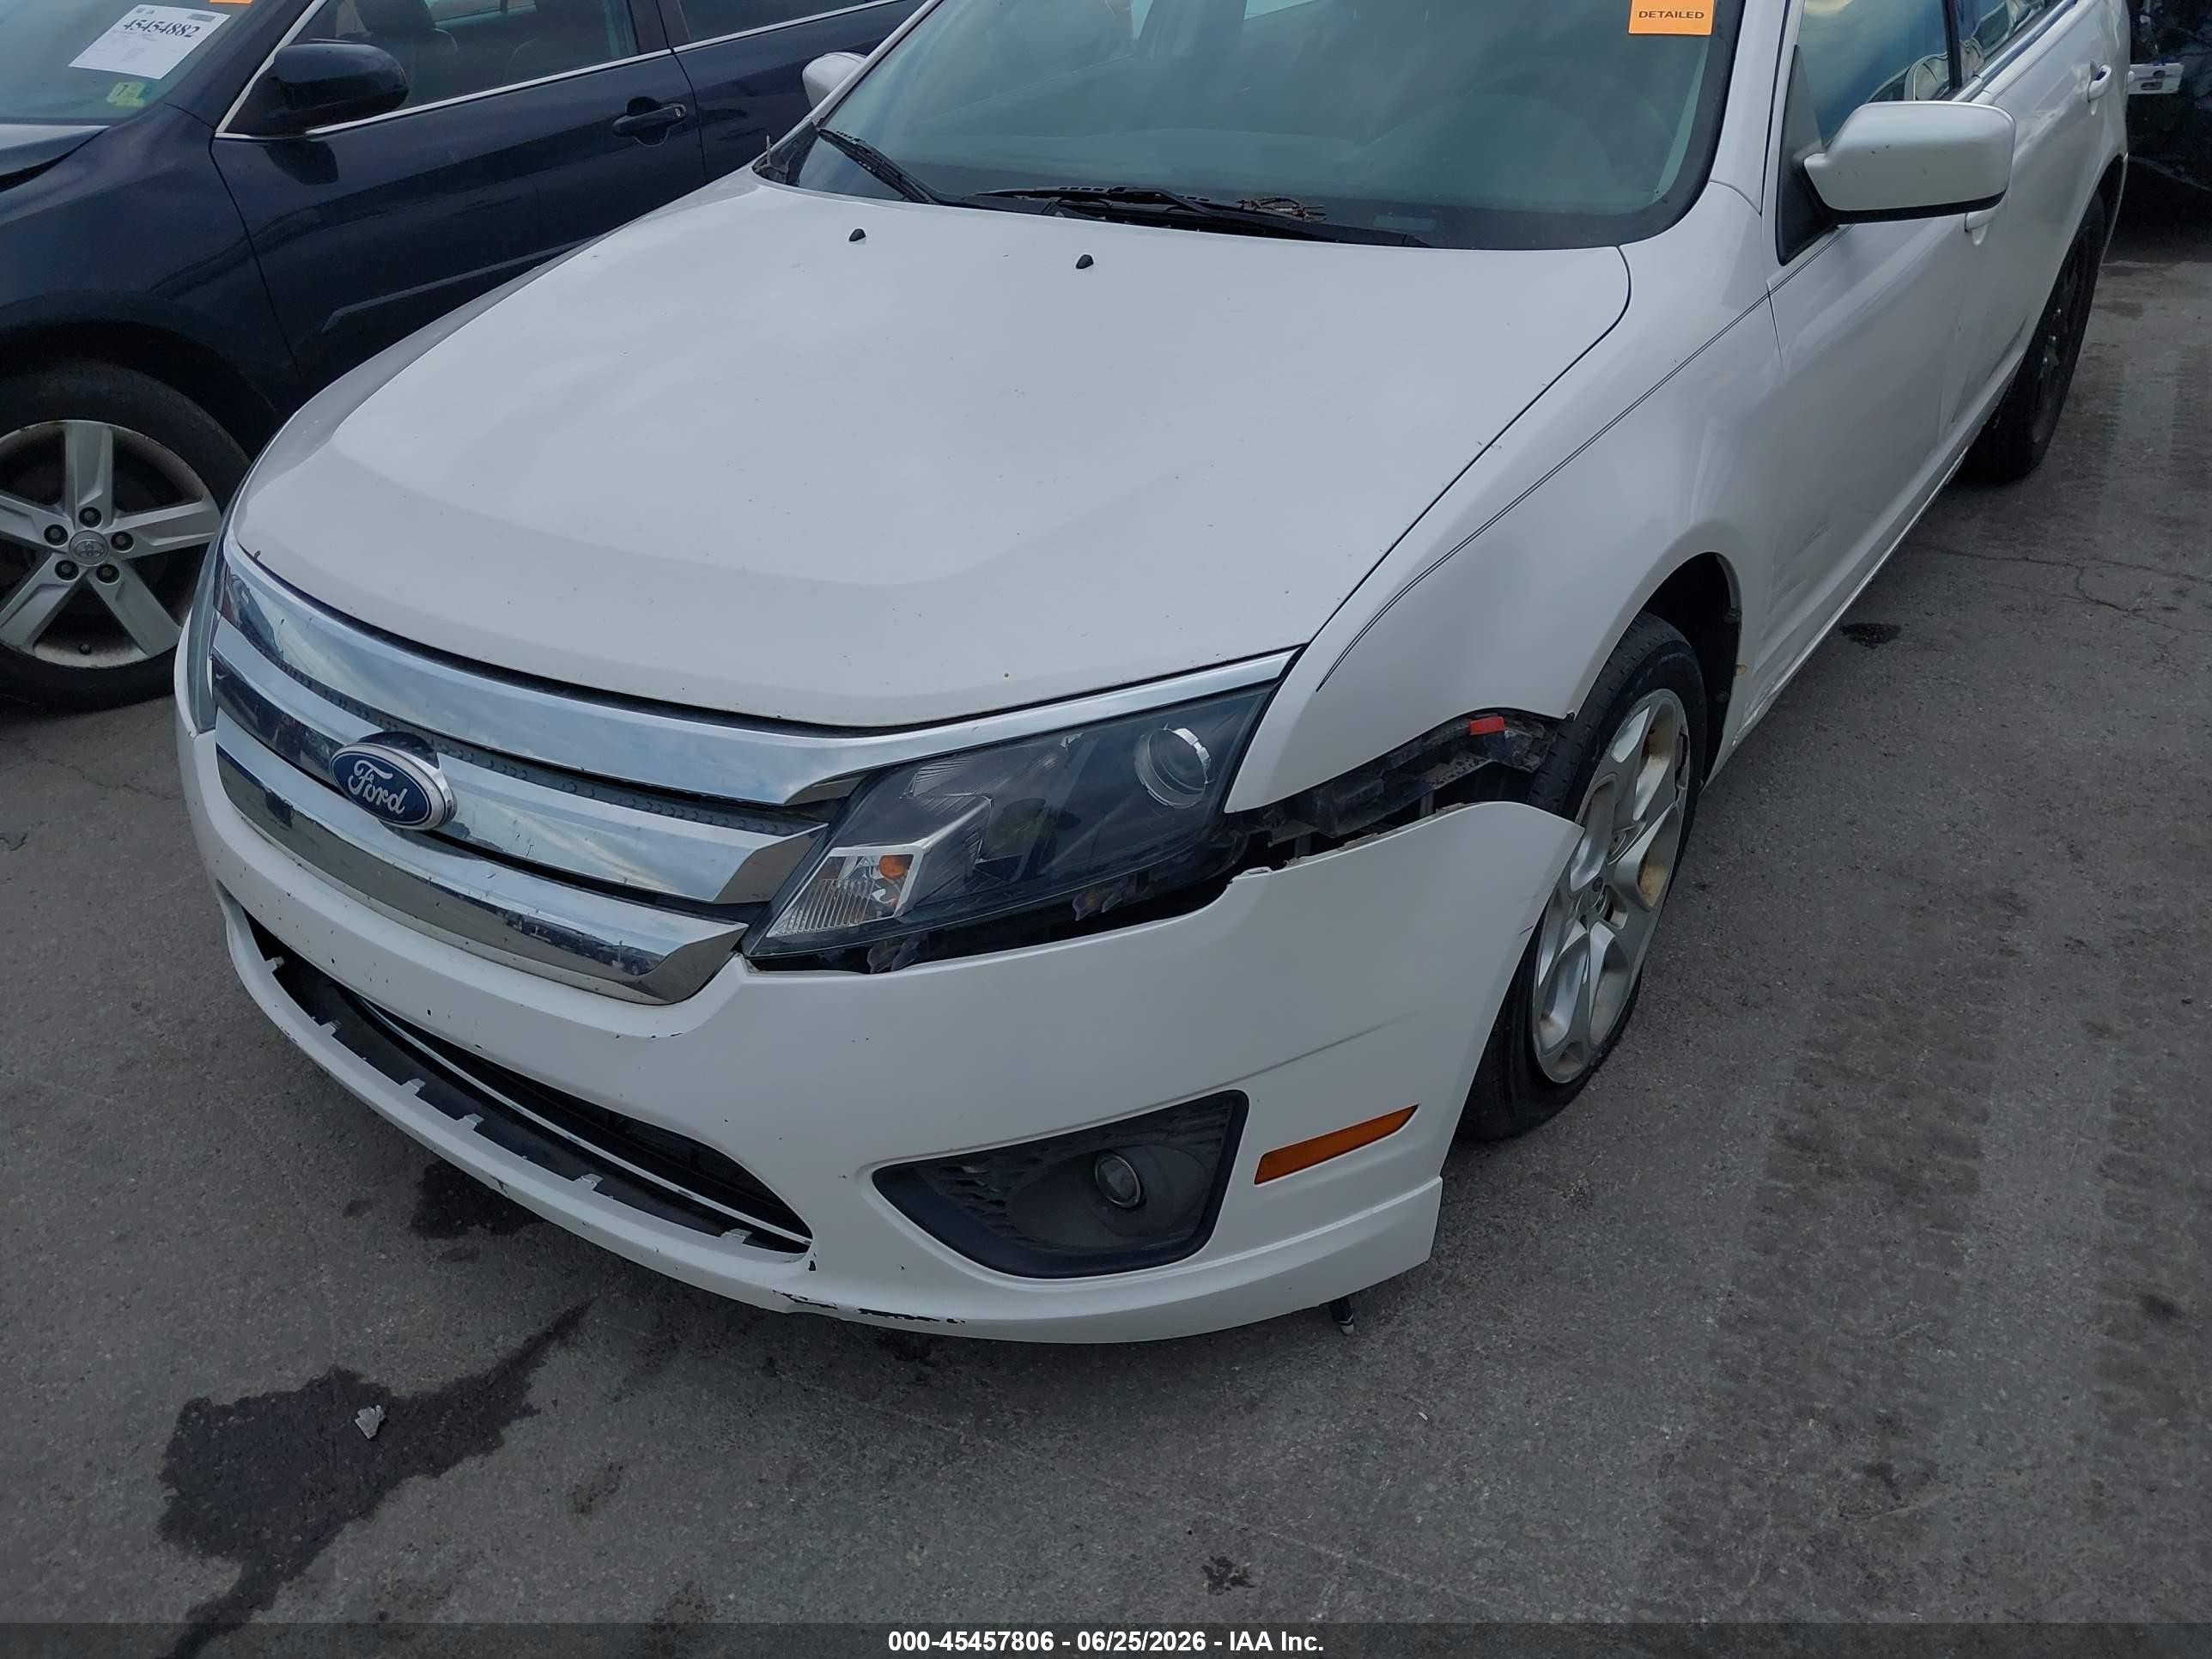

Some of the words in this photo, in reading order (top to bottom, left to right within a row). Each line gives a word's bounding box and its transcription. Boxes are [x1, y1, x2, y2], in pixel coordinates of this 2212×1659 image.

[1638, 10, 1705, 19] DETAILED
[123, 19, 201, 38] 45454882
[348, 760, 408, 814] Ford
